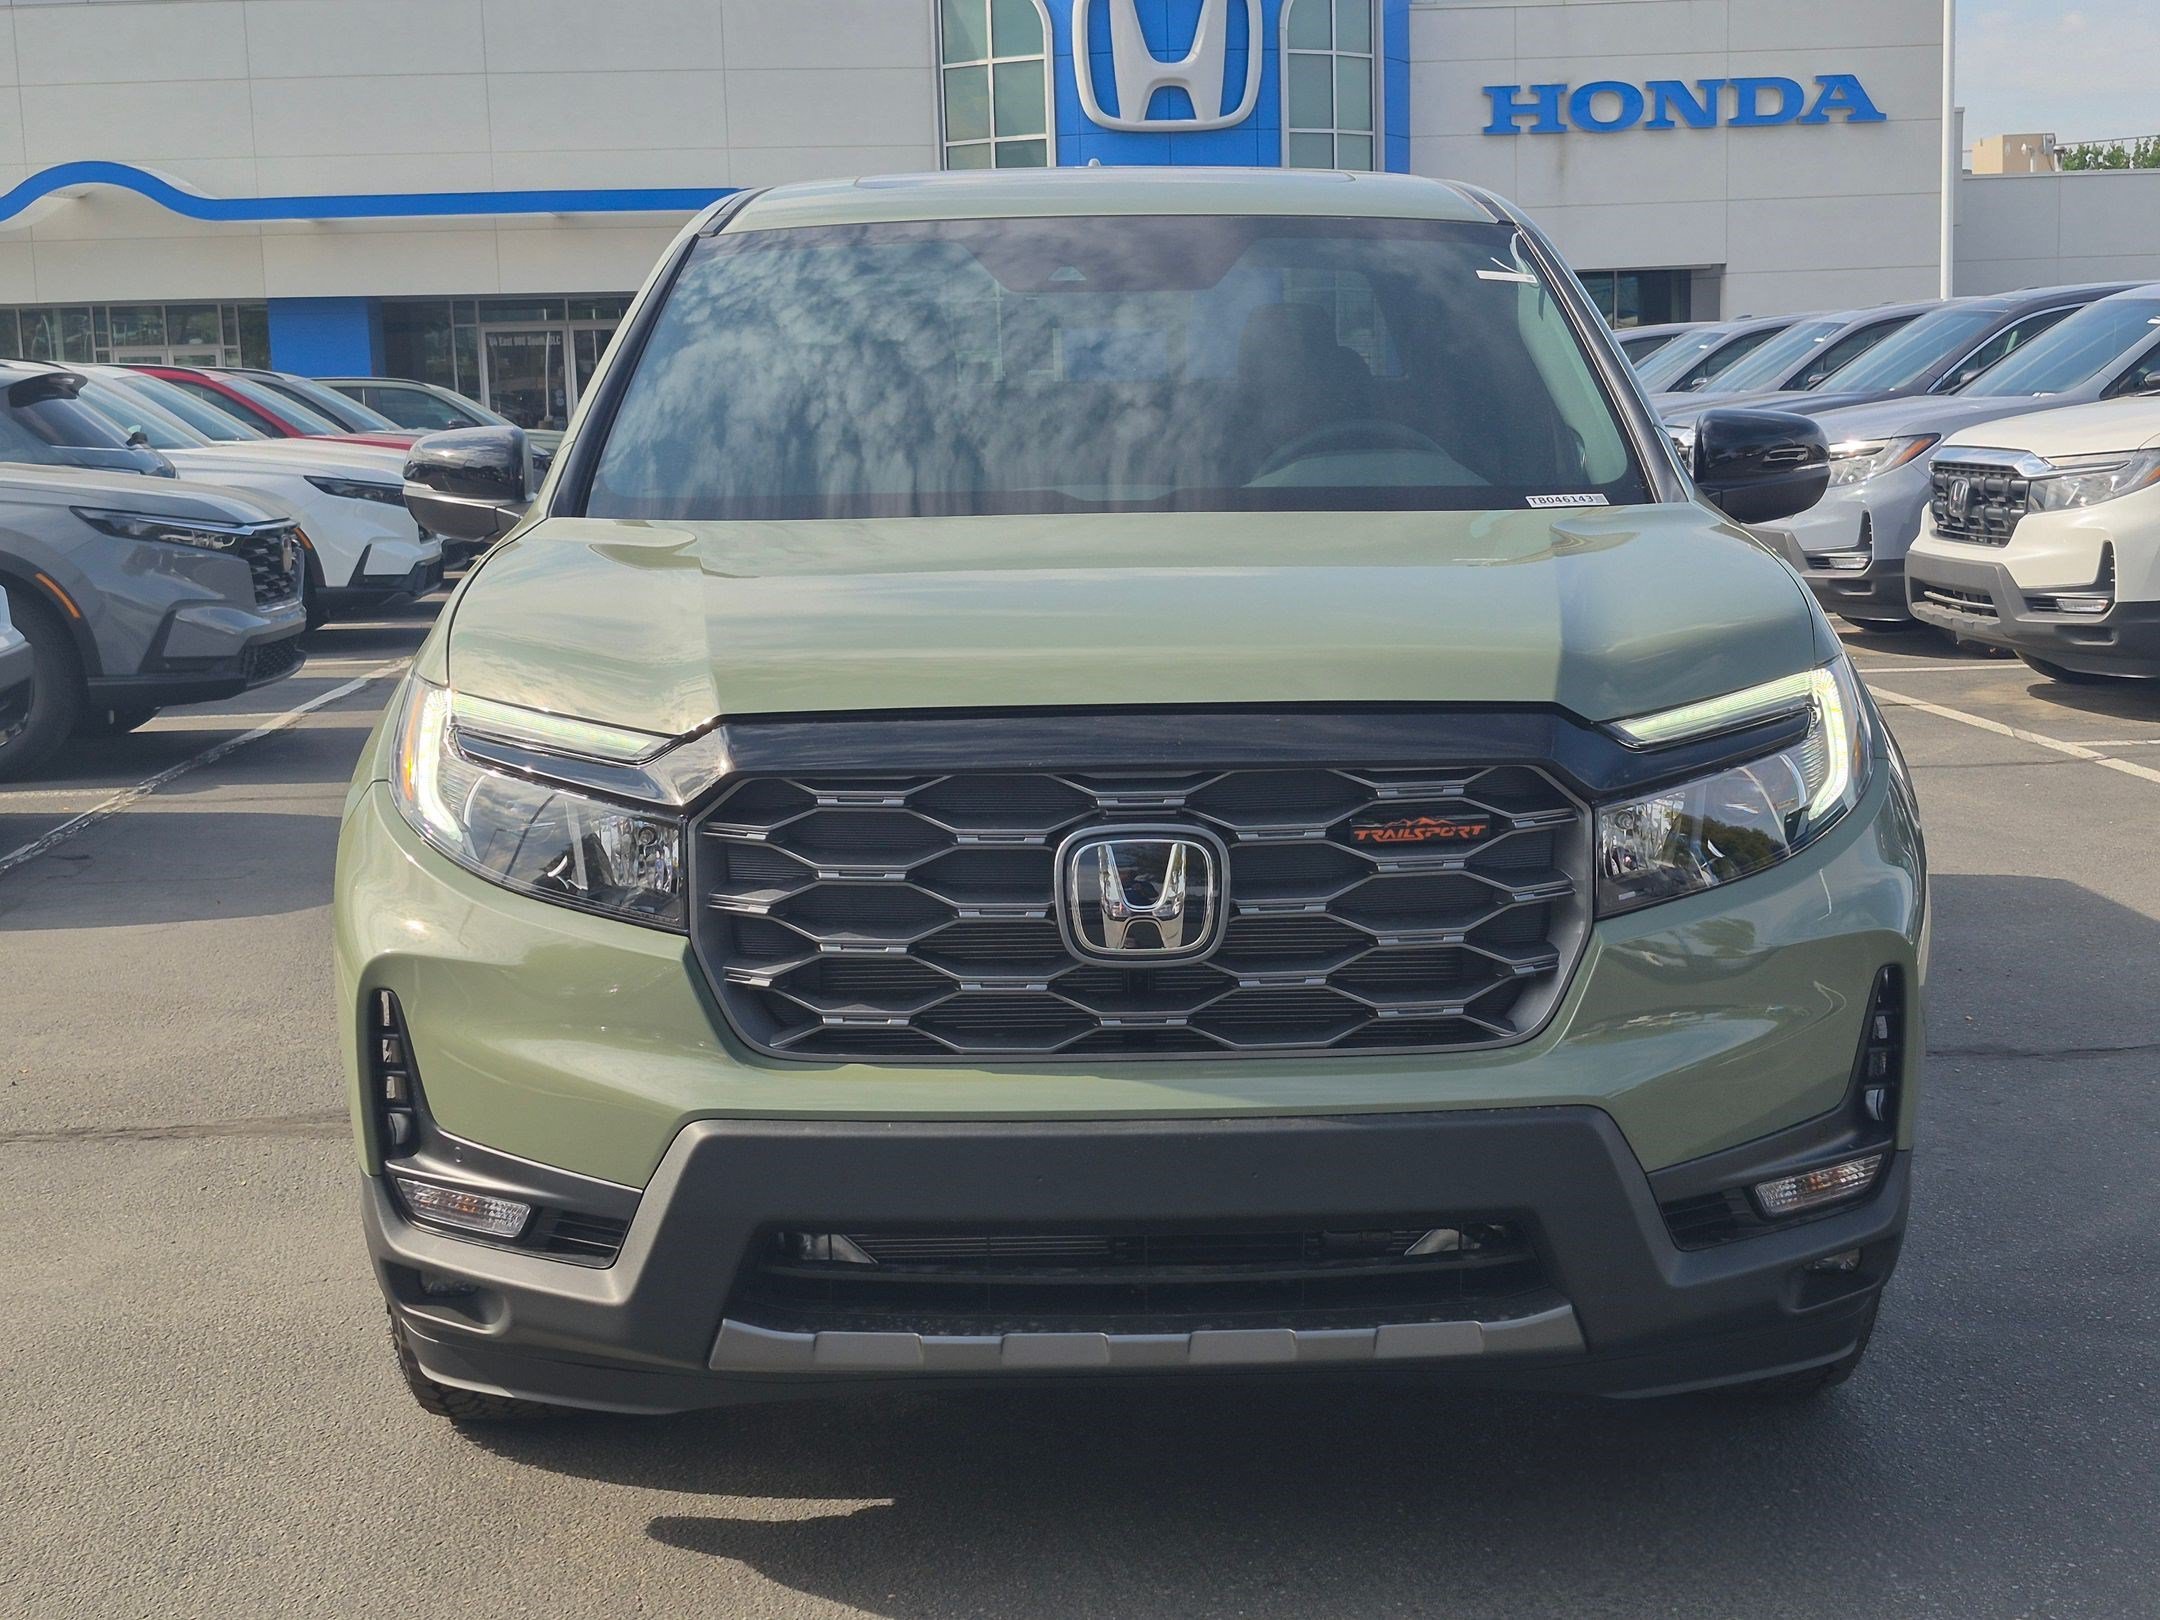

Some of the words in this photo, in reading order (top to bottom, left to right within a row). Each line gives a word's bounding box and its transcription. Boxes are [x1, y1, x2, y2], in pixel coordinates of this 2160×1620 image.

[1481, 73, 1888, 137] HONDA
[1528, 495, 1594, 505] TB046143
[1353, 825, 1486, 842] TRAILSPORT
